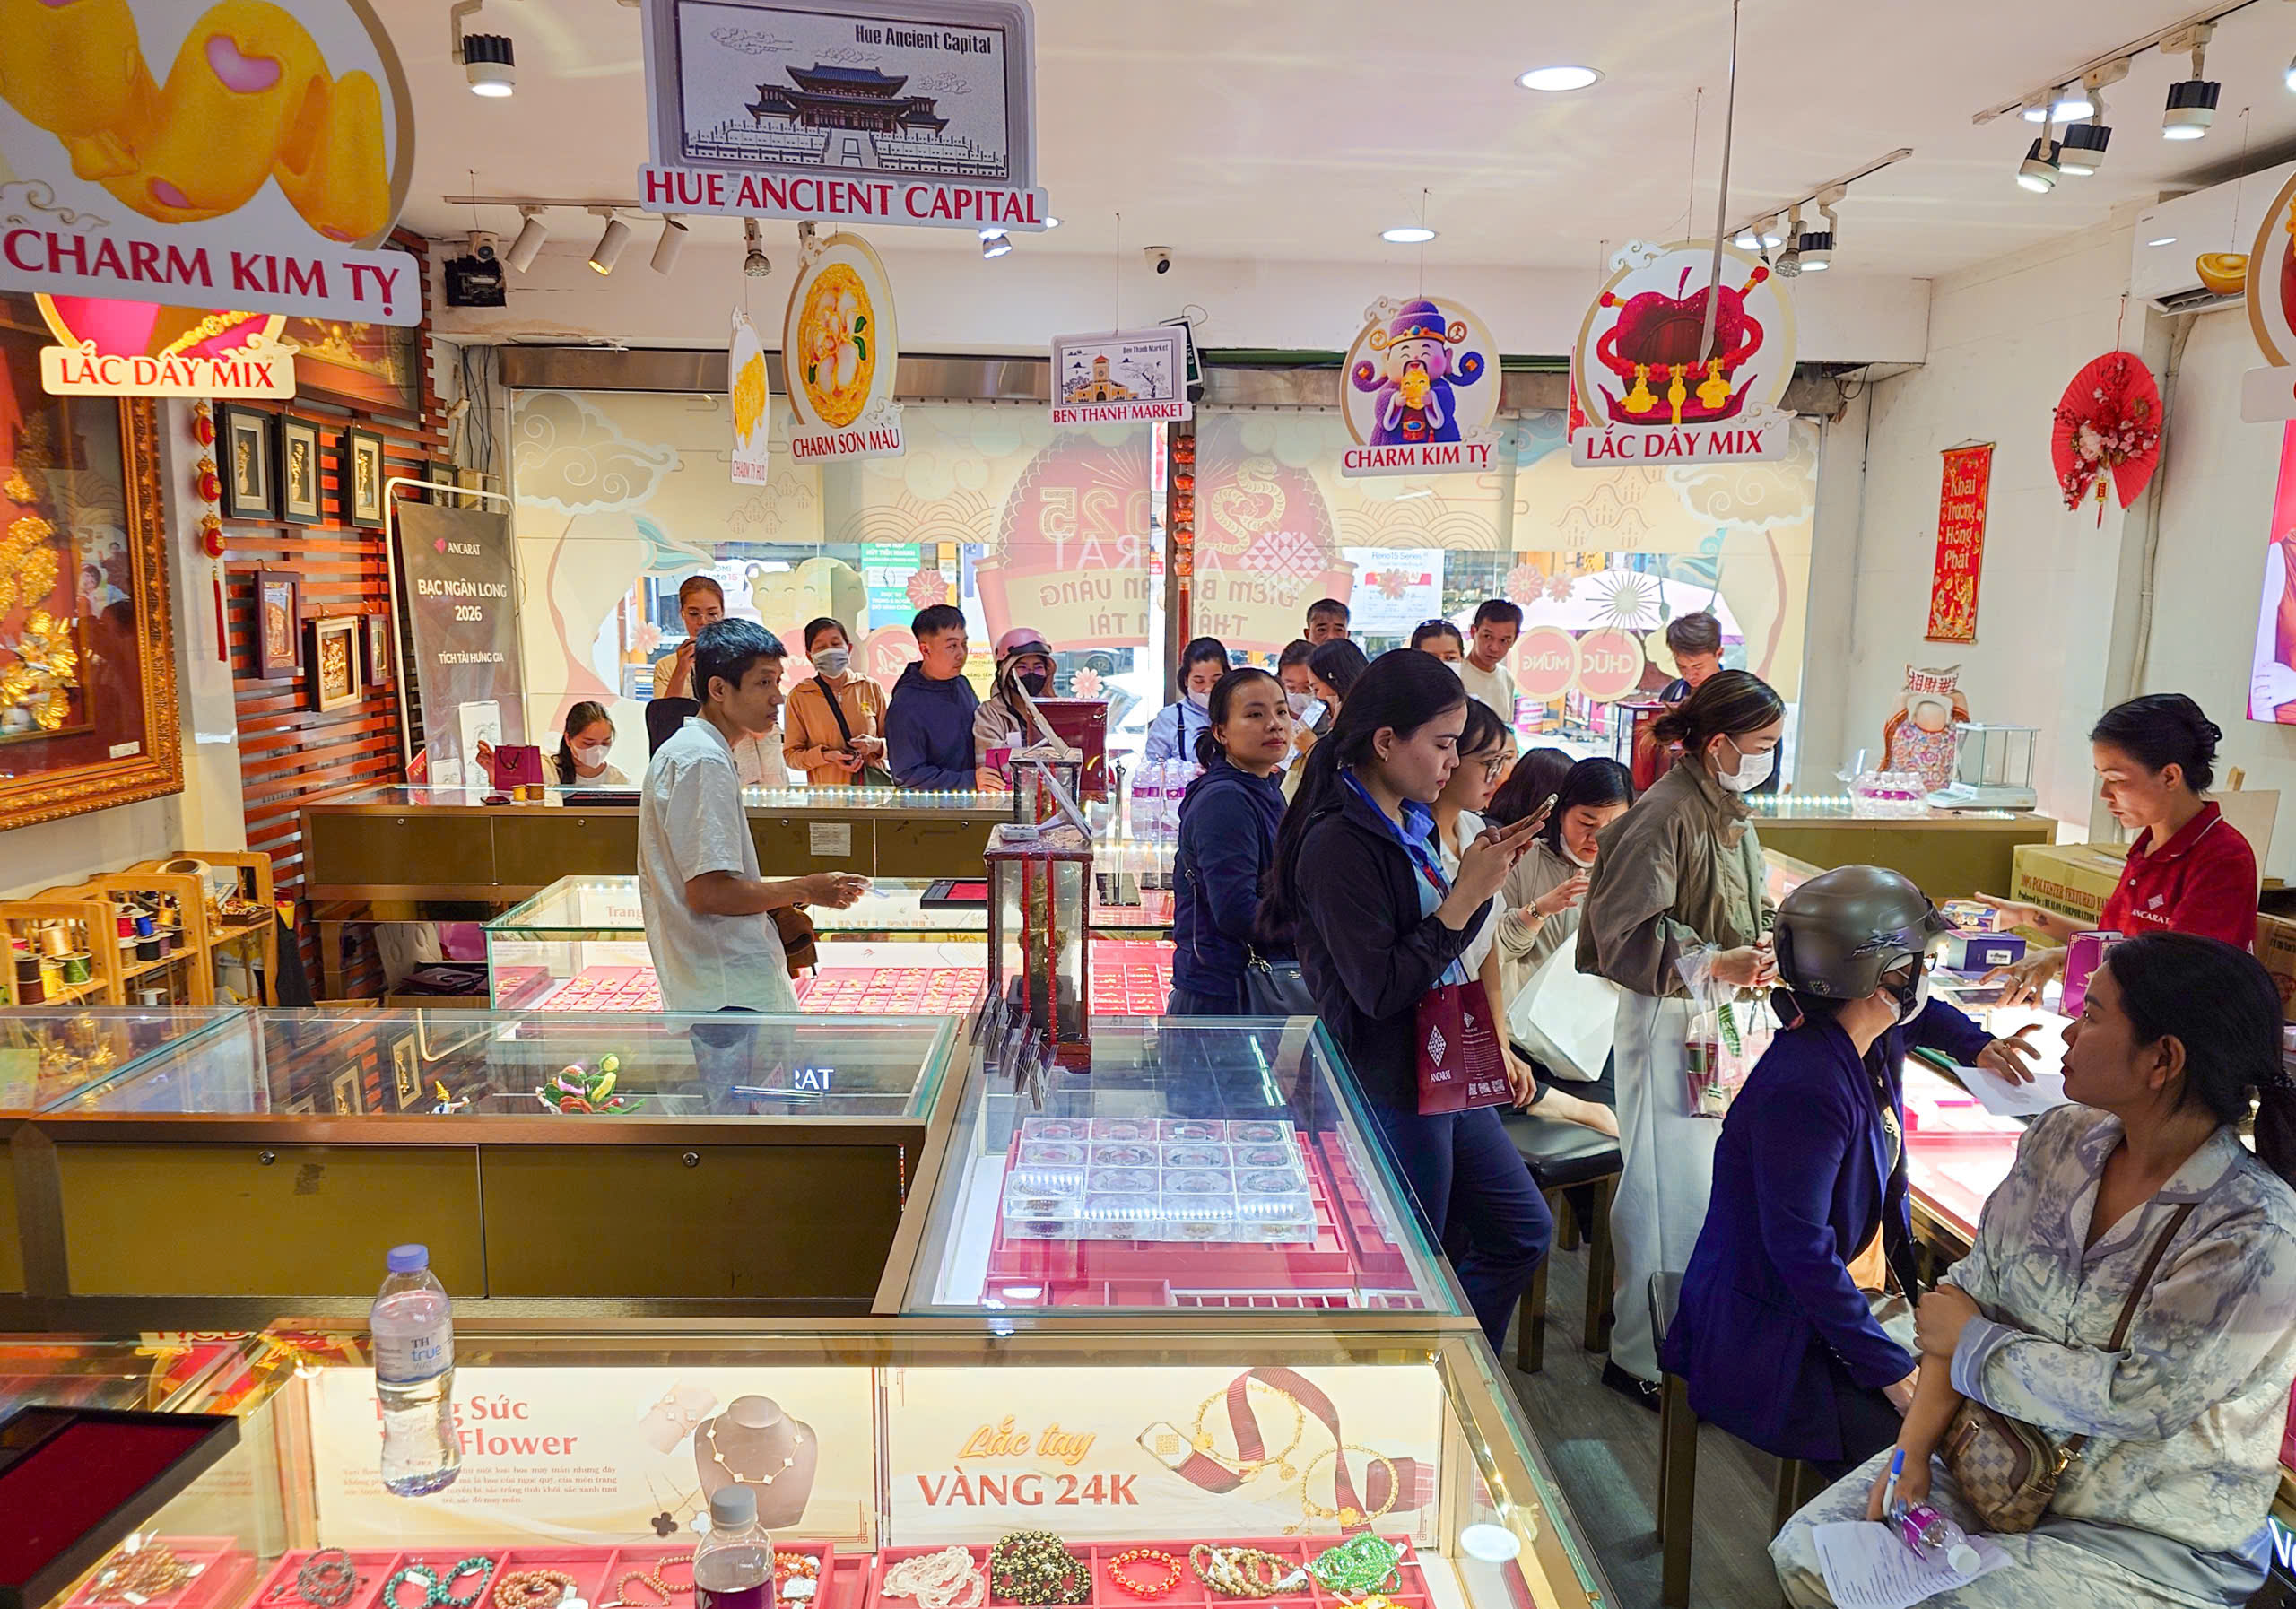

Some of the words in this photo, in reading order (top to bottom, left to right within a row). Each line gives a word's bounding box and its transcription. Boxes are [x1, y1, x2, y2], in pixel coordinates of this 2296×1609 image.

[855, 23, 882, 45] Hue
[884, 27, 941, 50] Ancient
[943, 31, 992, 55] Capital
[645, 169, 726, 207] HUE
[735, 175, 890, 216] ANCIENT
[904, 185, 1042, 224] CAPITAL
[3, 229, 213, 288] CHARM
[230, 250, 329, 299] KIM
[341, 262, 401, 317] TỴ
[1122, 346, 1133, 354] Ben
[1133, 345, 1148, 353] Thanh
[1149, 344, 1169, 352] Market
[60, 342, 123, 387] LẮC
[134, 352, 201, 387] DÂY
[210, 361, 276, 389] MIX
[1053, 409, 1077, 423] BEN
[1081, 406, 1127, 422] THANH
[1131, 403, 1185, 419] MARKET
[792, 434, 837, 458] CHARM
[868, 422, 900, 450] MÀU
[1586, 423, 1636, 460] LẮC
[1644, 428, 1702, 459] DÂY
[1708, 428, 1764, 455] MIX
[1344, 447, 1416, 470] CHARM
[1422, 445, 1461, 466] KIM
[1467, 443, 1492, 470] TỴ
[1950, 474, 1977, 498] Khai
[1945, 522, 1973, 549] Hồng
[448, 542, 481, 556] ANCARAT
[1944, 546, 1970, 570] Phát
[417, 578, 443, 599] BẠC
[444, 578, 477, 597] NGÂN
[478, 582, 508, 598] LONG
[454, 605, 483, 621] 2026
[438, 650, 457, 665] TÍCH
[457, 650, 470, 664] TÀI
[493, 653, 504, 663] GIA
[2131, 908, 2171, 926] ANCARAT
[1430, 1069, 1452, 1083] ANCARAT
[410, 1344, 442, 1363] true
[411, 1336, 430, 1350] TH
[470, 1394, 529, 1420] Sức
[457, 1427, 578, 1457] Flower
[957, 1414, 1032, 1460] Lắc
[1036, 1422, 1096, 1466] tay
[916, 1465, 1044, 1507] VÀNG
[1054, 1474, 1140, 1506] 24K
